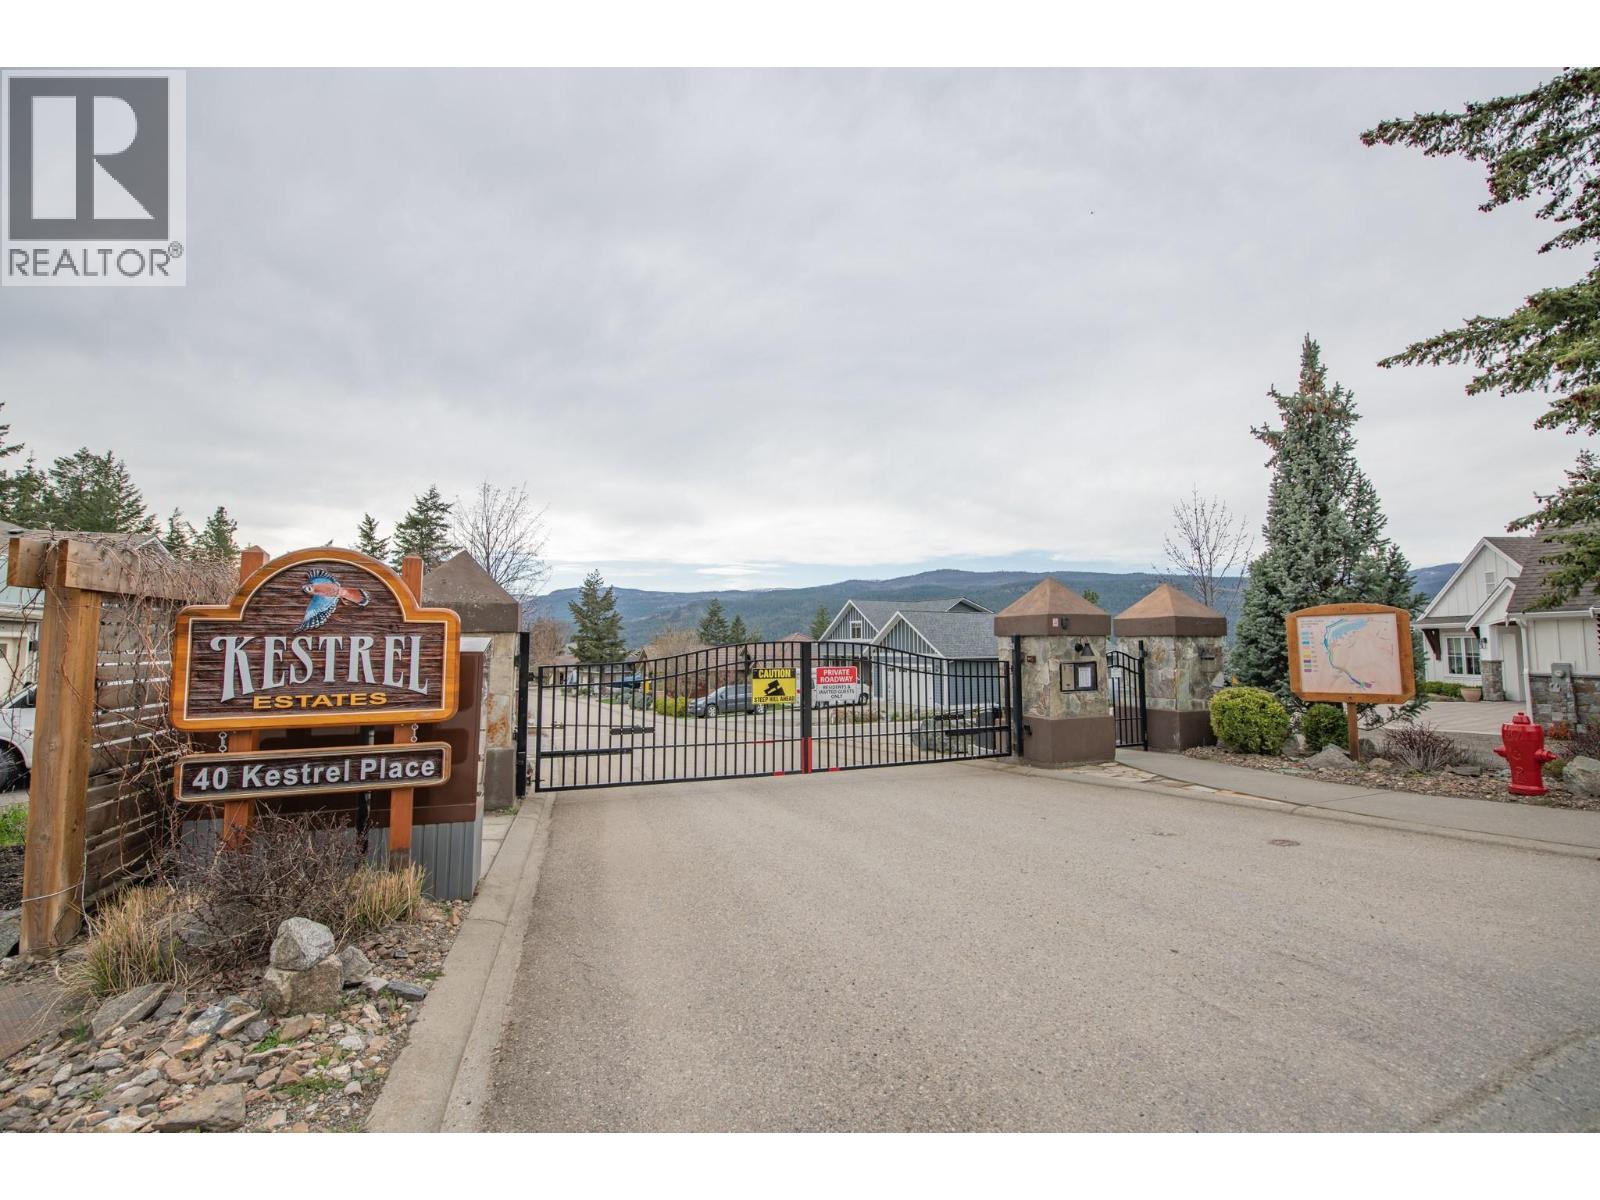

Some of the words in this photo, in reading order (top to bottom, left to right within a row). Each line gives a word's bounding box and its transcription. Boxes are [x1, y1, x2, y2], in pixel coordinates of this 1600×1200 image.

[210, 636, 428, 703] KESTREL
[758, 669, 791, 678] CAUTION
[253, 692, 388, 710] ESTATES
[192, 766, 229, 790] 40
[242, 759, 350, 788] Kestrel
[360, 758, 436, 780] Place
